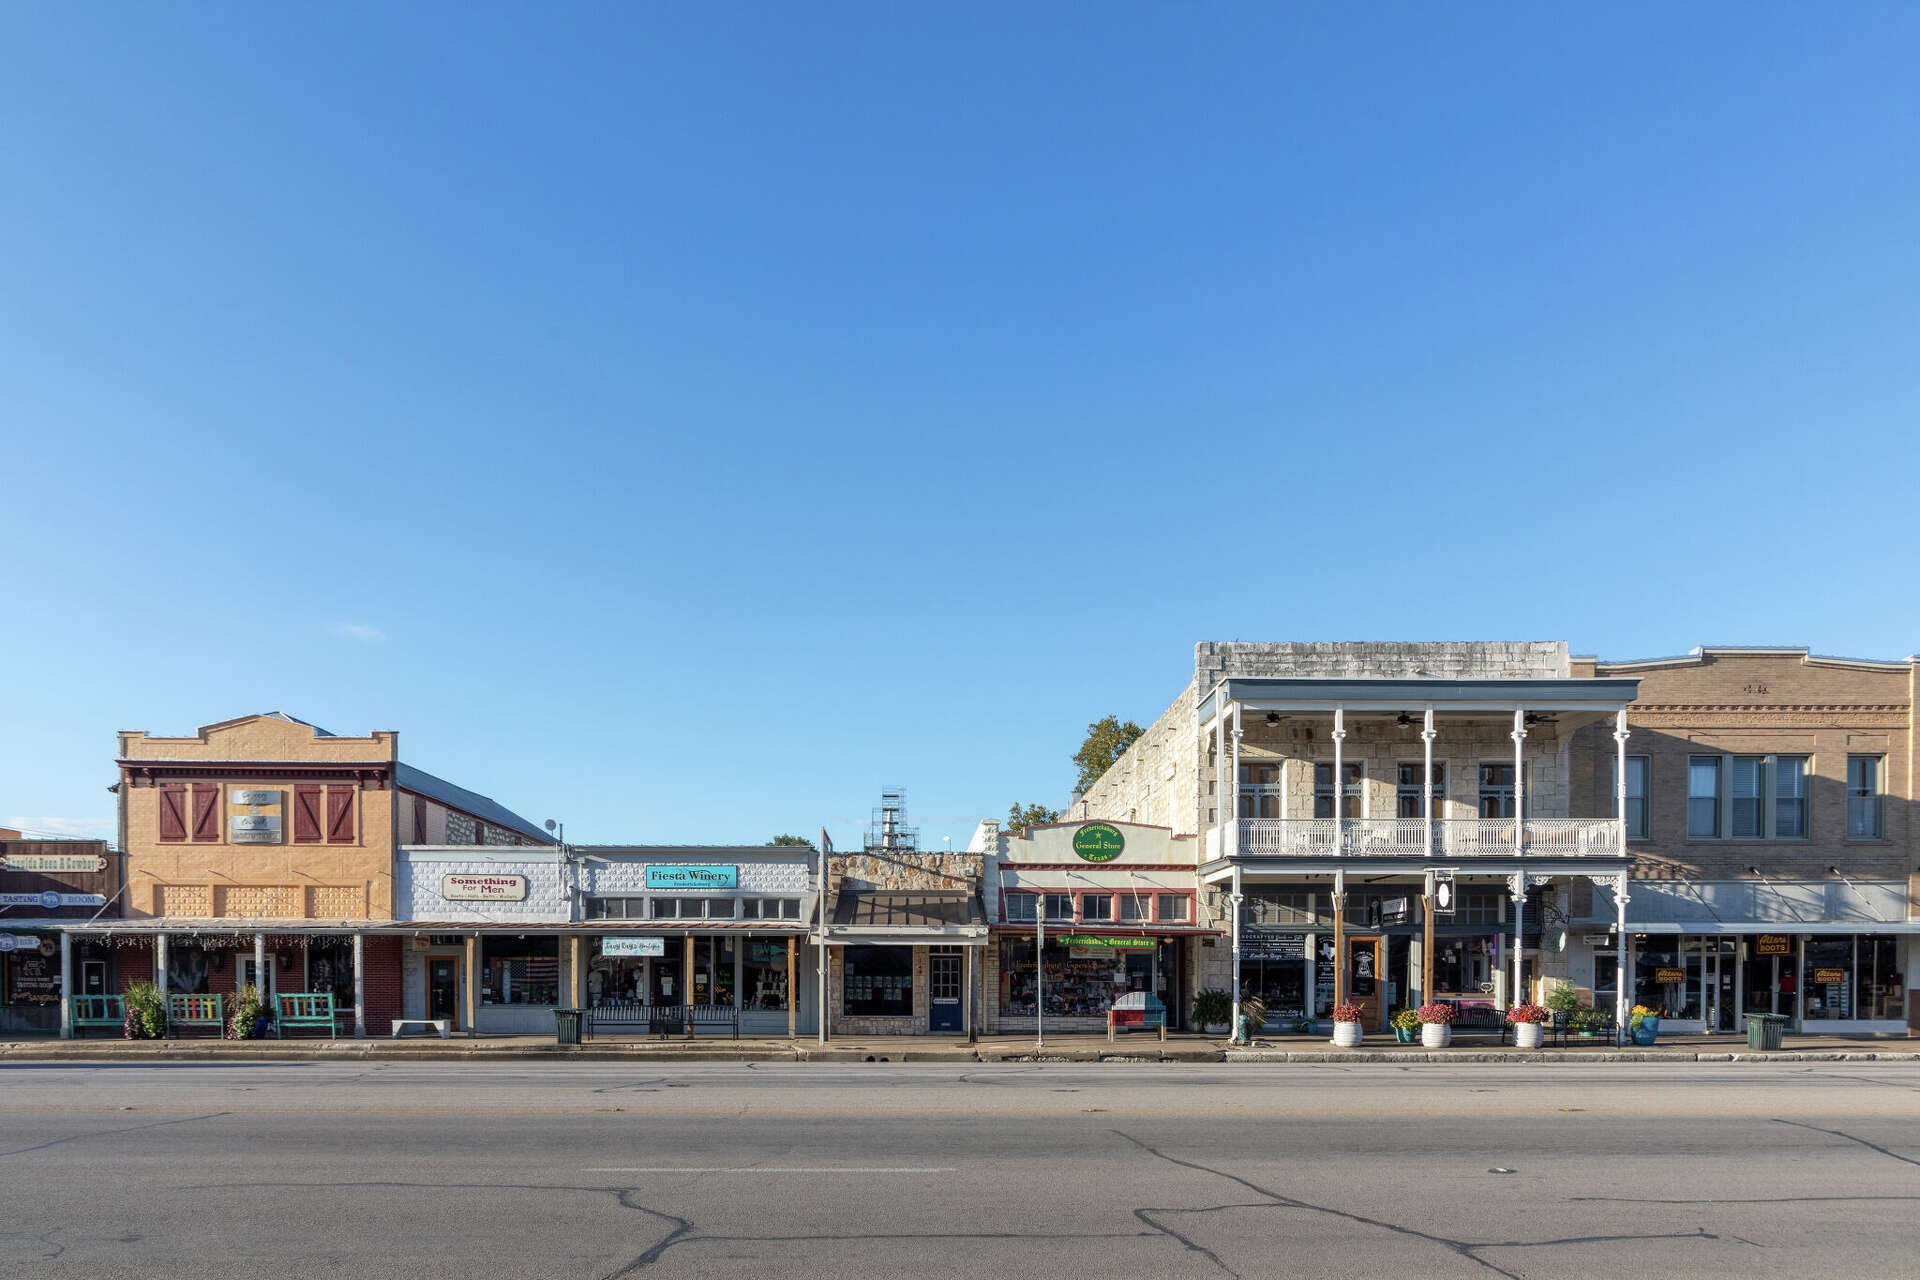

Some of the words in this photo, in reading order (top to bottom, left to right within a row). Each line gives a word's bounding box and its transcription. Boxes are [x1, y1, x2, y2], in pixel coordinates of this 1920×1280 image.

[1075, 840, 1102, 849] General
[1103, 841, 1121, 849] Store
[652, 871, 686, 881] Fiesta
[688, 870, 730, 882] Winery
[450, 877, 517, 886] Something
[481, 885, 505, 893] Men
[2, 895, 38, 903] TASTING
[67, 895, 96, 903] ROOM
[1109, 937, 1132, 946] General
[1133, 938, 1150, 946] Store
